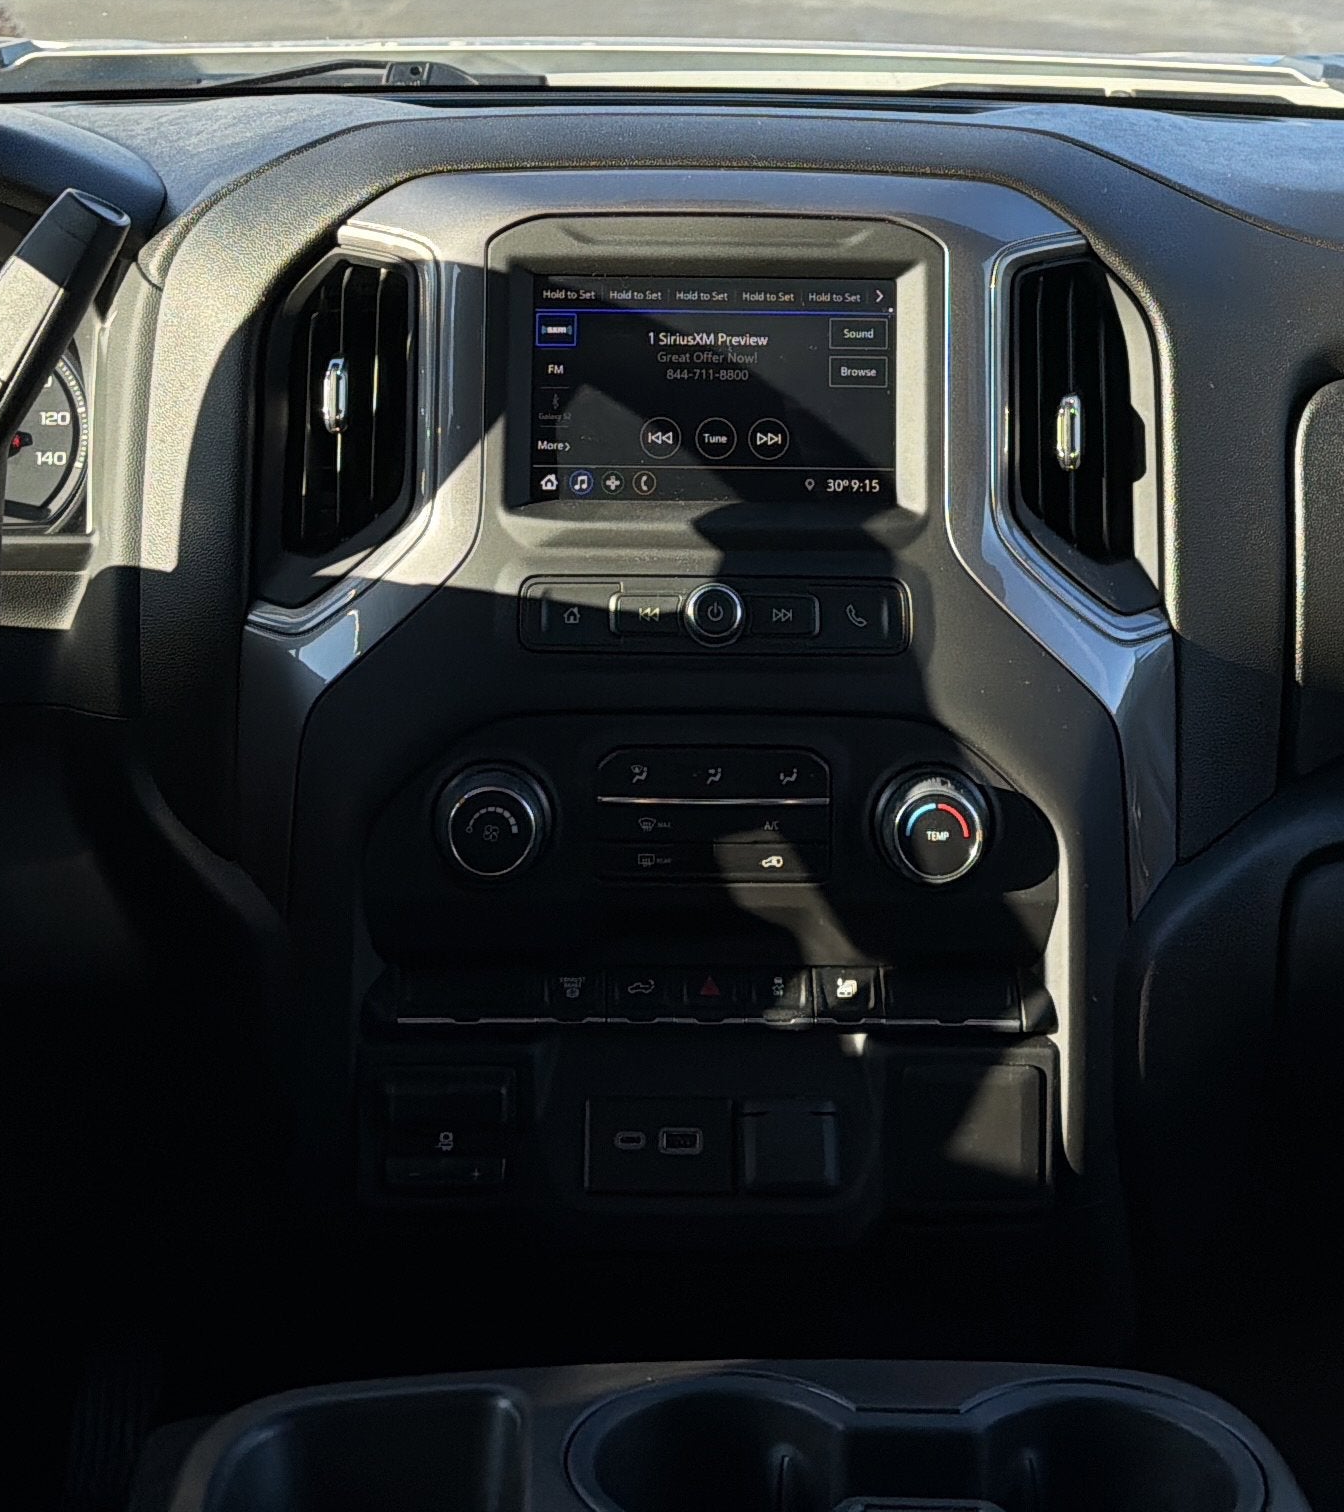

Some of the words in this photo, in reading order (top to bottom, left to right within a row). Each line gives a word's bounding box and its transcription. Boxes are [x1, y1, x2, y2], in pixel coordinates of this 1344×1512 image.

[543, 290, 565, 300] Hold
[568, 291, 575, 300] to
[577, 290, 595, 300] Set
[609, 290, 632, 300] Hold
[634, 291, 642, 300] to
[645, 290, 661, 300] Set
[676, 291, 698, 301] Hold
[701, 292, 709, 301] to
[711, 291, 728, 301] Set
[742, 292, 765, 302] Hold
[767, 293, 776, 302] to
[778, 292, 794, 302] Set
[808, 292, 831, 302] Hold
[833, 293, 842, 302] to
[844, 292, 860, 302] Set
[648, 332, 654, 345] 1
[659, 332, 715, 346] SiriusXM
[718, 333, 768, 347] Preview
[844, 328, 874, 340] Sound
[657, 352, 690, 364] Great
[693, 352, 725, 364] Offer
[728, 352, 758, 364] Now!
[548, 364, 563, 375] FM
[667, 369, 749, 381] 844-711-8800
[841, 366, 877, 378] Browse
[40, 412, 70, 426] 120
[703, 433, 728, 444] Tune
[538, 441, 564, 452] More
[37, 452, 67, 466] 140
[851, 480, 880, 493] 9:15
[763, 820, 780, 831] A/C
[925, 831, 950, 842] TEMP
